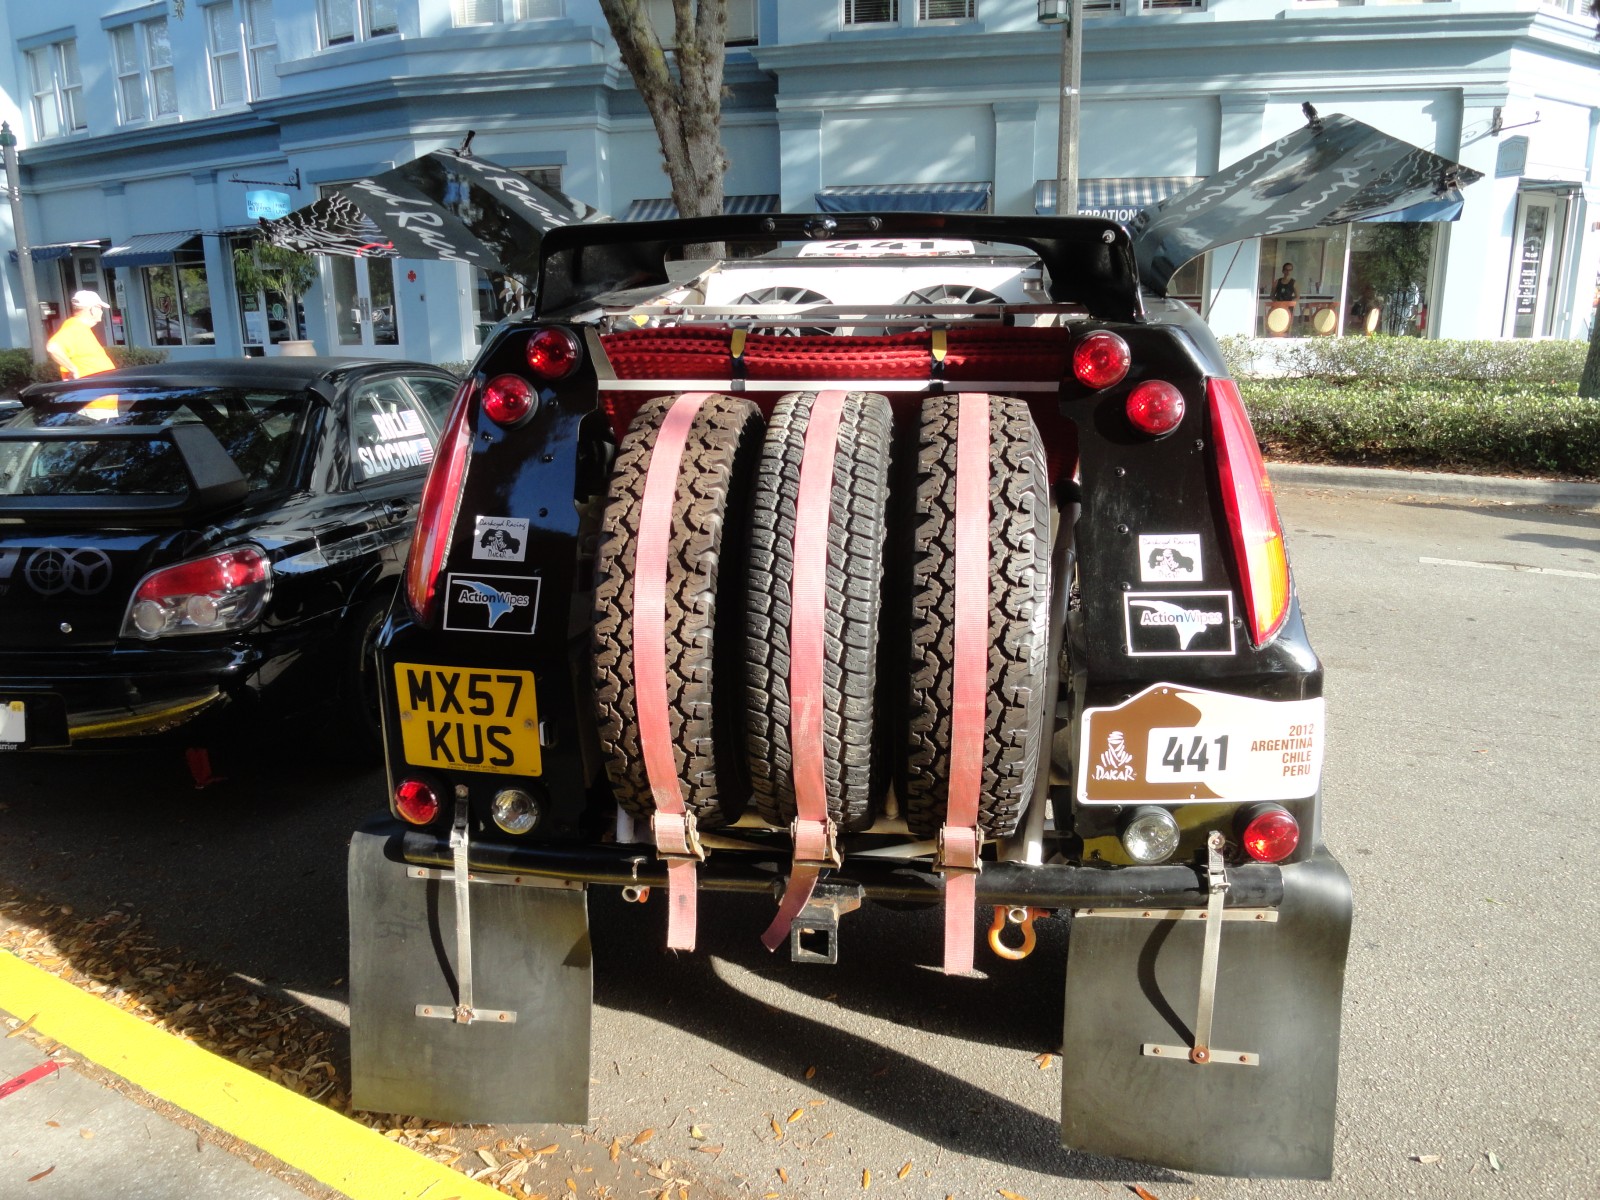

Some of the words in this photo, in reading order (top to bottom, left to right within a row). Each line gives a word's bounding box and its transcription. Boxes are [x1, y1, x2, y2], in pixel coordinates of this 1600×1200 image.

[358, 440, 422, 475] SLOCUM
[505, 519, 527, 531] Racing
[459, 590, 529, 607] ActionWipes
[1142, 611, 1223, 625] ActionWipes
[406, 669, 523, 718] MX57
[1288, 723, 1314, 737] 2012
[426, 720, 515, 767] KUS
[1250, 737, 1313, 752] ARGENTINA
[1161, 734, 1229, 773] 441
[1281, 751, 1312, 764] CHILE
[1095, 765, 1136, 781] DAKAR
[1282, 764, 1311, 777] PERU
